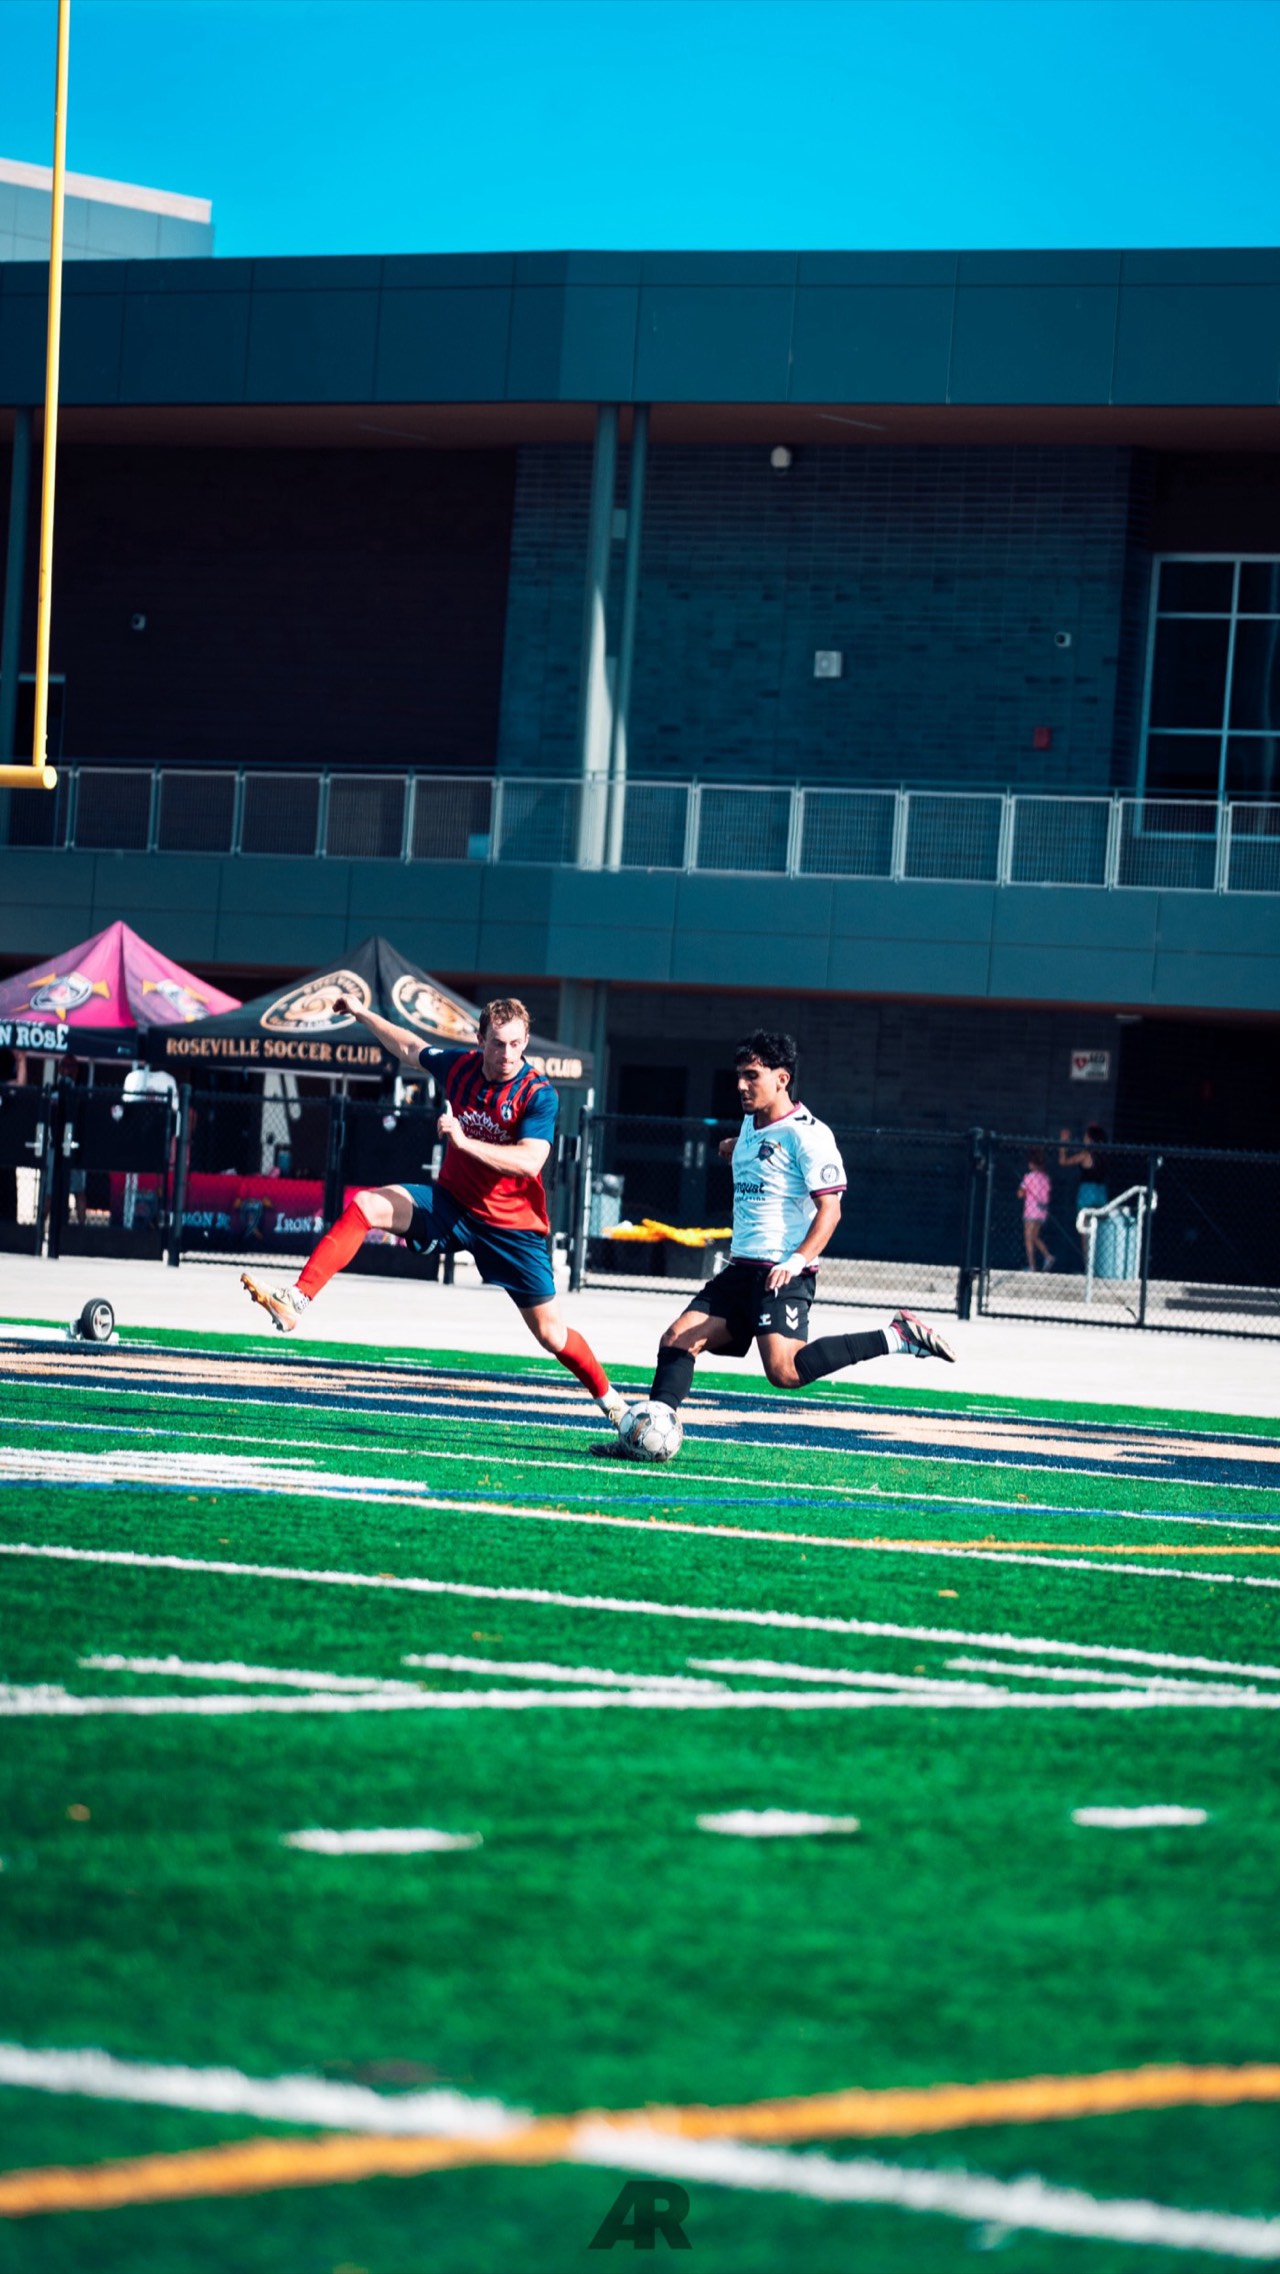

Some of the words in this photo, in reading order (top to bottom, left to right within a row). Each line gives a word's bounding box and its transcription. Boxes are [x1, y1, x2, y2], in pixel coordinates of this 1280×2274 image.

[166, 1038, 259, 1057] ROSEVILLE
[264, 1039, 332, 1061] SOCCER
[336, 1045, 382, 1064] CLUB
[546, 1057, 582, 1079] CLUB
